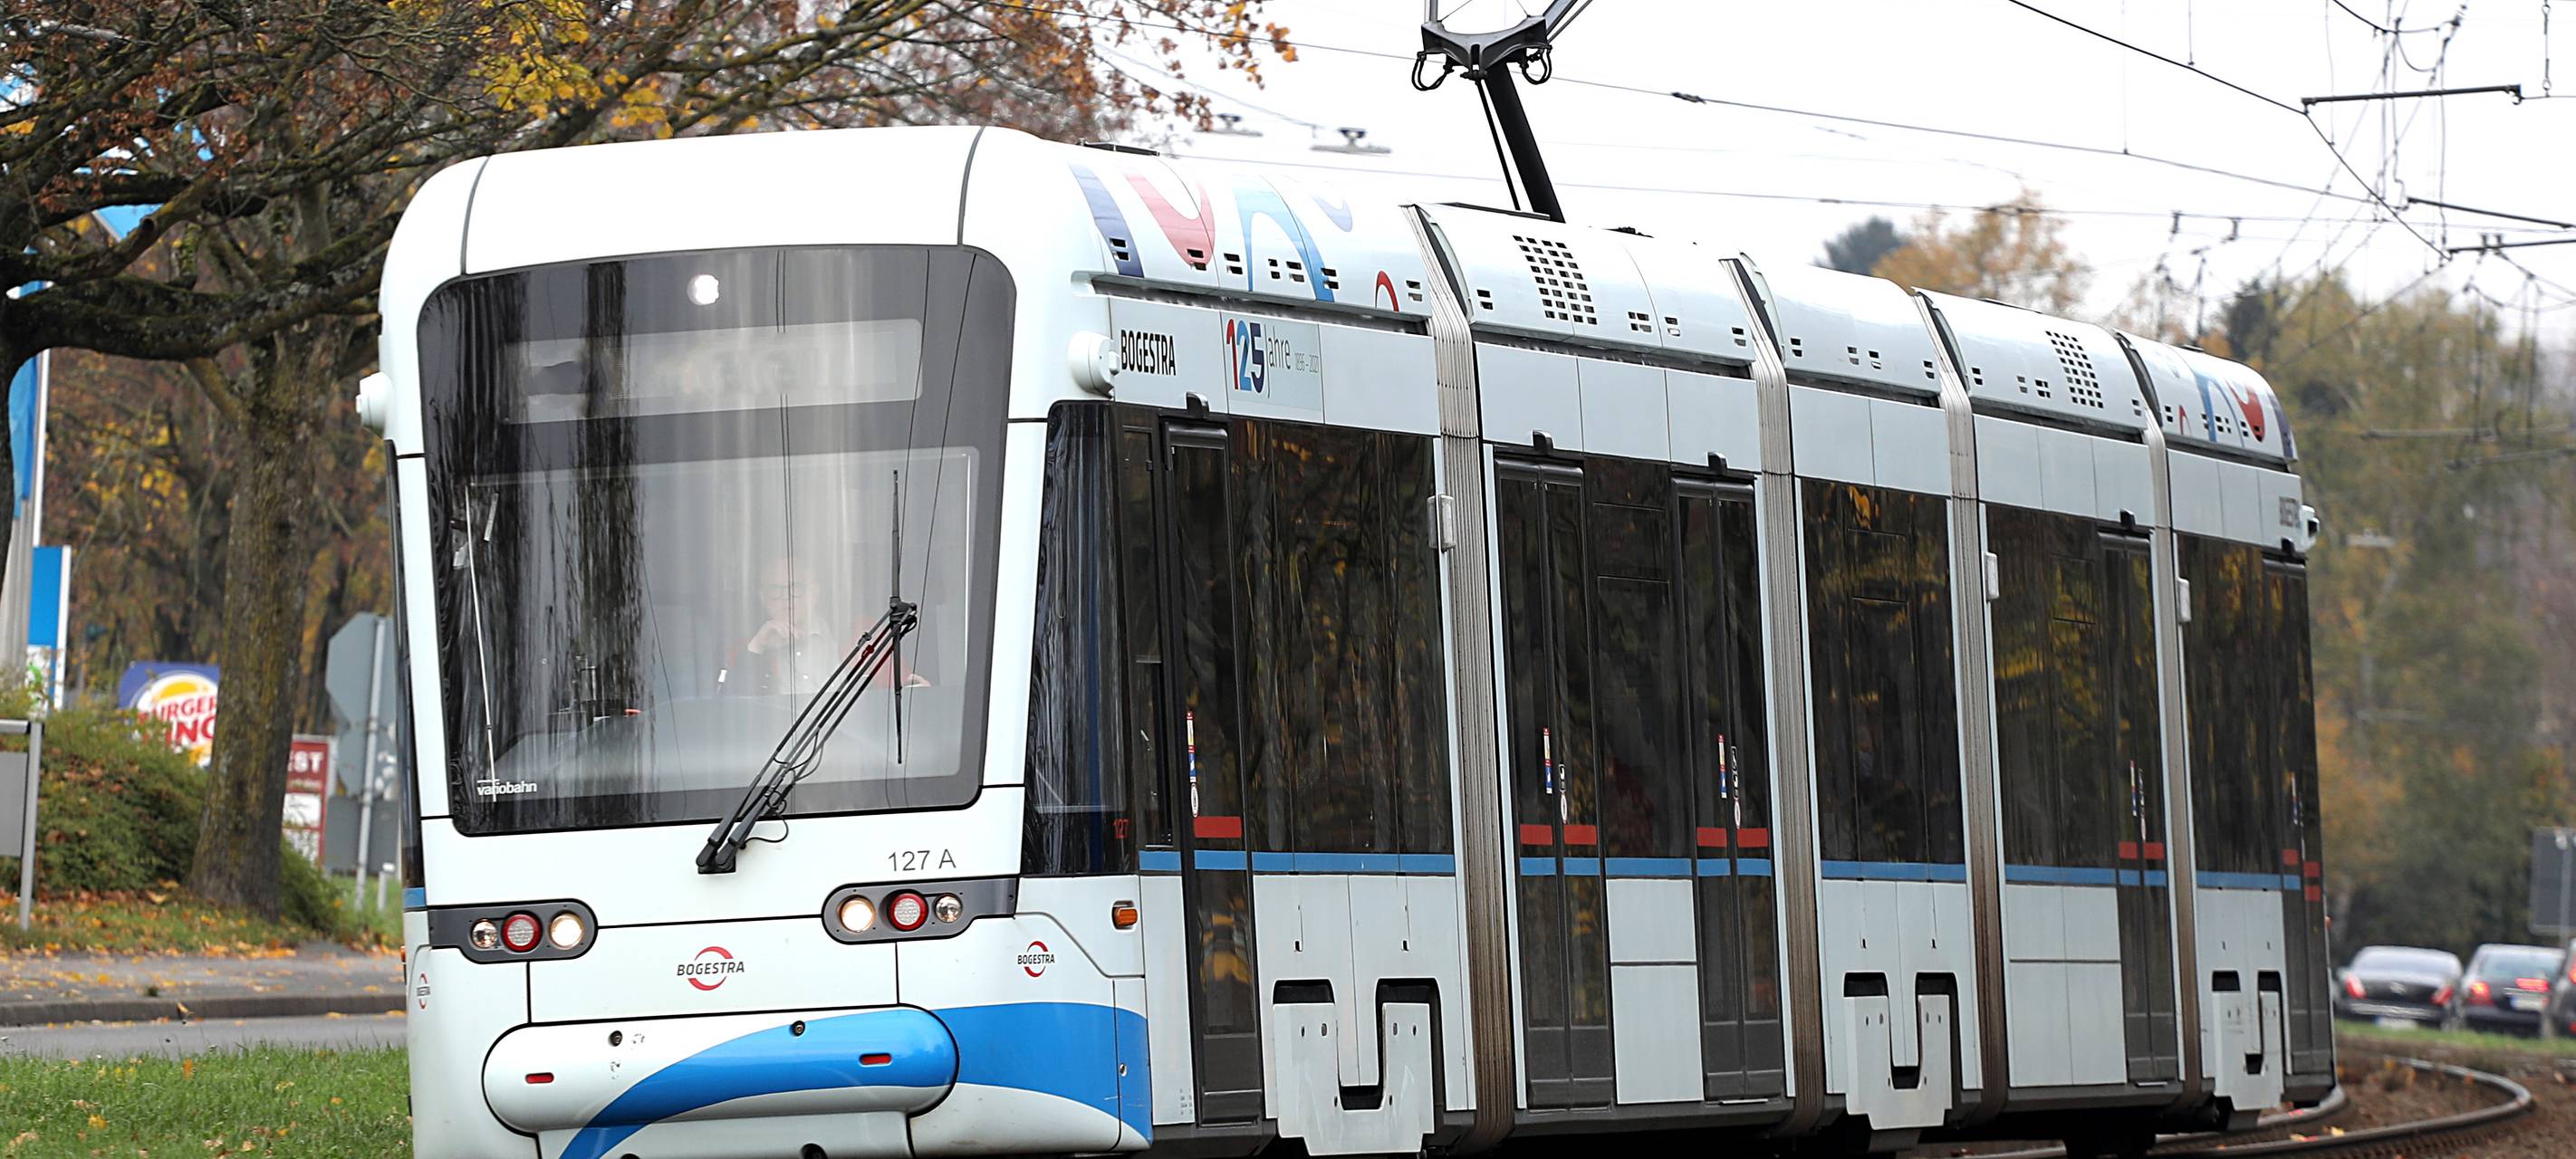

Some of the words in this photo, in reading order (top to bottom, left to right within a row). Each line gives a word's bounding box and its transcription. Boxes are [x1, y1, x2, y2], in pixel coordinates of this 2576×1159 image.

[1120, 329, 1177, 377] BOGESTRA
[1226, 319, 1265, 394] 125
[138, 694, 216, 726] URGE
[888, 850, 930, 872] 127
[938, 848, 956, 869] A
[677, 961, 745, 976] BOGESTRA
[1017, 953, 1055, 964] BOGESTRA
